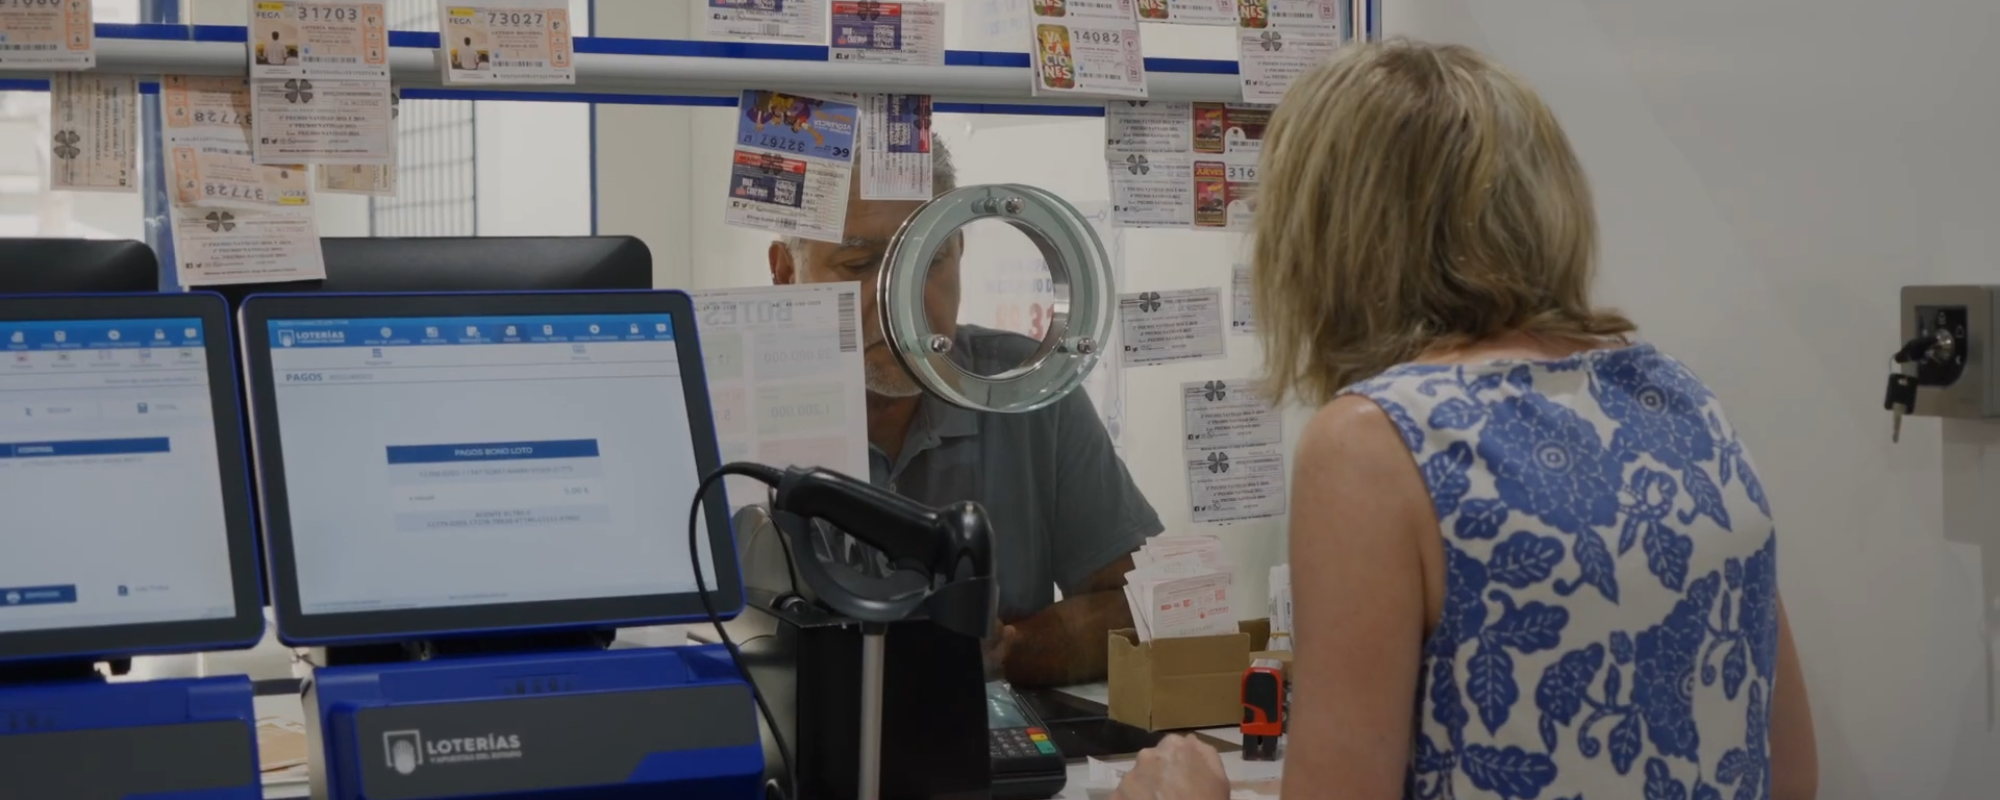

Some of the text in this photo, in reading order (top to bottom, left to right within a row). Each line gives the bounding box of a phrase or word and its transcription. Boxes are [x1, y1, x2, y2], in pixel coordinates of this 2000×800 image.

[298, 7, 357, 20] 31703
[1240, 5, 1264, 19] NES
[488, 12, 543, 25] 73027
[1073, 30, 1120, 44] 14082
[1046, 42, 1065, 54] CA
[1044, 66, 1071, 79] NES
[813, 120, 851, 131] VIOLENCIA
[760, 135, 805, 152] 32767
[832, 146, 850, 158] 6€
[1196, 168, 1223, 176] JUEVES
[1228, 167, 1255, 178] 316
[205, 184, 264, 200] 37728
[296, 329, 345, 340] LOTERÍAS
[286, 373, 323, 382] PAGOS
[454, 446, 533, 456] PAGOS BONO LOTO
[426, 732, 521, 755] LOTERÍAS
